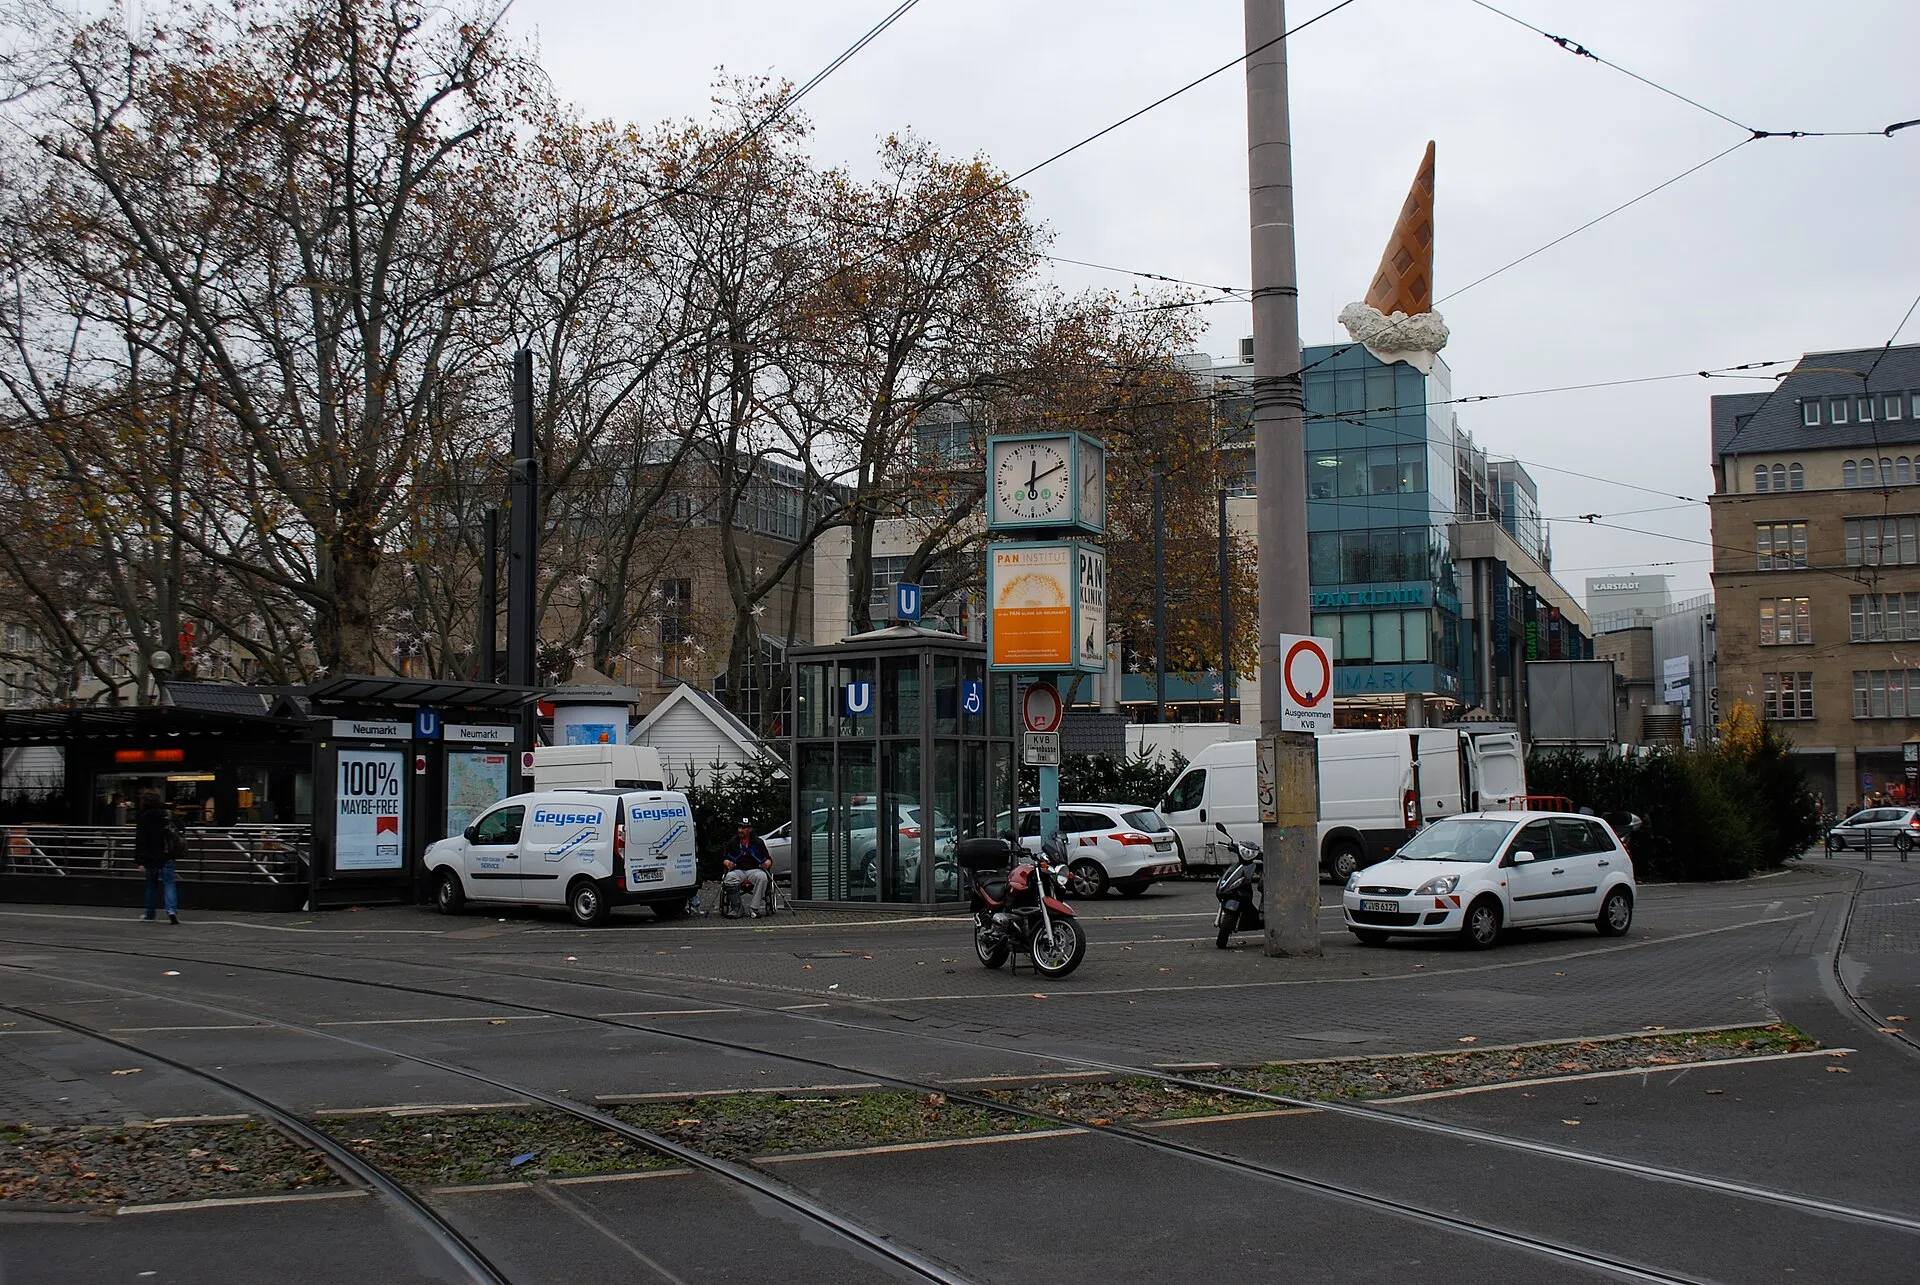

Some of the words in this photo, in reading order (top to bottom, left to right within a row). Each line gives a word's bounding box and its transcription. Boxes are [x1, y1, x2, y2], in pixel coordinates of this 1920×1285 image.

[998, 555, 1019, 563] PAN
[1022, 551, 1067, 563] INSTITUT
[1079, 554, 1102, 589] PAN
[1592, 582, 1640, 592] KARSTADT
[901, 589, 915, 615] U
[1079, 586, 1103, 607] KLINIK
[1314, 591, 1349, 608] PAN
[1359, 588, 1424, 605] KLINIK
[1525, 621, 1537, 660] GRAVIS
[1336, 671, 1414, 690] IMARK
[848, 683, 869, 712] U
[1284, 708, 1331, 718] Ausgenommen
[353, 724, 397, 735] Neumarkt
[420, 713, 434, 735] U
[1300, 720, 1315, 729] KVB
[460, 728, 499, 739] Neumarkt
[1033, 736, 1051, 744] KVB
[1037, 753, 1047, 762] frei
[341, 761, 398, 796] 100%
[340, 799, 399, 815] MAYBE-FREE
[632, 806, 686, 820] Geyssel
[534, 810, 603, 827] Geyssel
[1380, 902, 1397, 912] 6127
